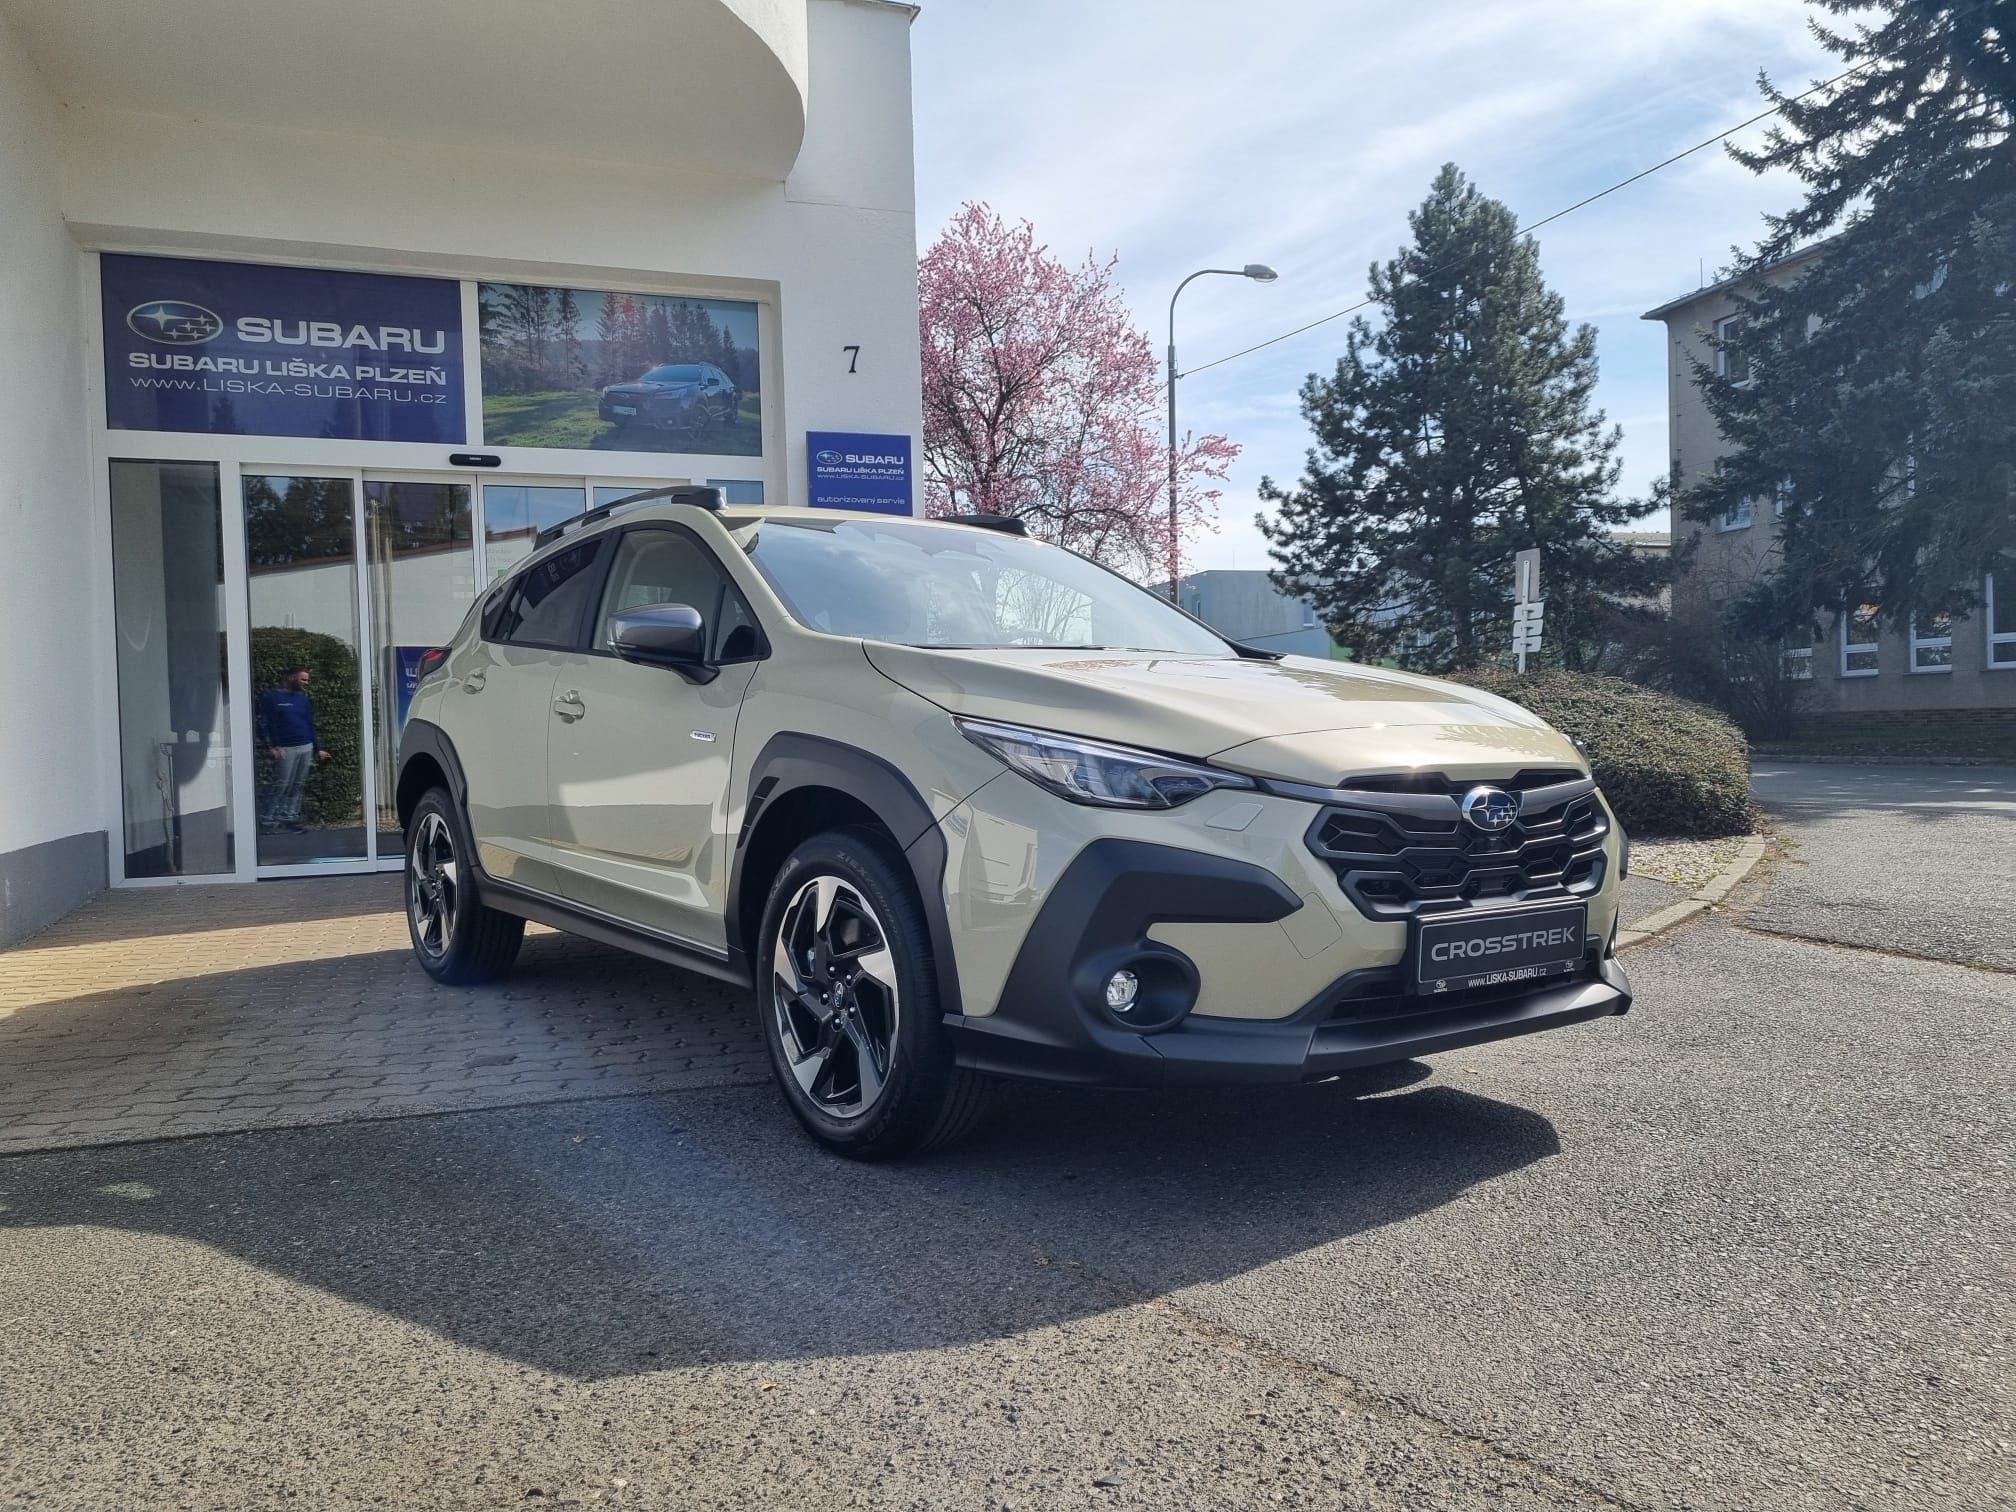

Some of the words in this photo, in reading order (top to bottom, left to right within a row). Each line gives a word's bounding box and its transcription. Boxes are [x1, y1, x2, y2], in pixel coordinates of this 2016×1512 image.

[236, 317, 445, 354] SUBARU
[128, 352, 260, 374] SUBARU
[266, 357, 350, 380] LIŠKA
[355, 366, 447, 385] PLZEŇ
[843, 345, 860, 373] 7
[845, 454, 904, 465] SUBARU
[853, 466, 877, 475] LIŠKA
[817, 496, 875, 505] autorizovaný
[876, 497, 905, 505] servis
[1431, 926, 1576, 962] CROSSTREK
